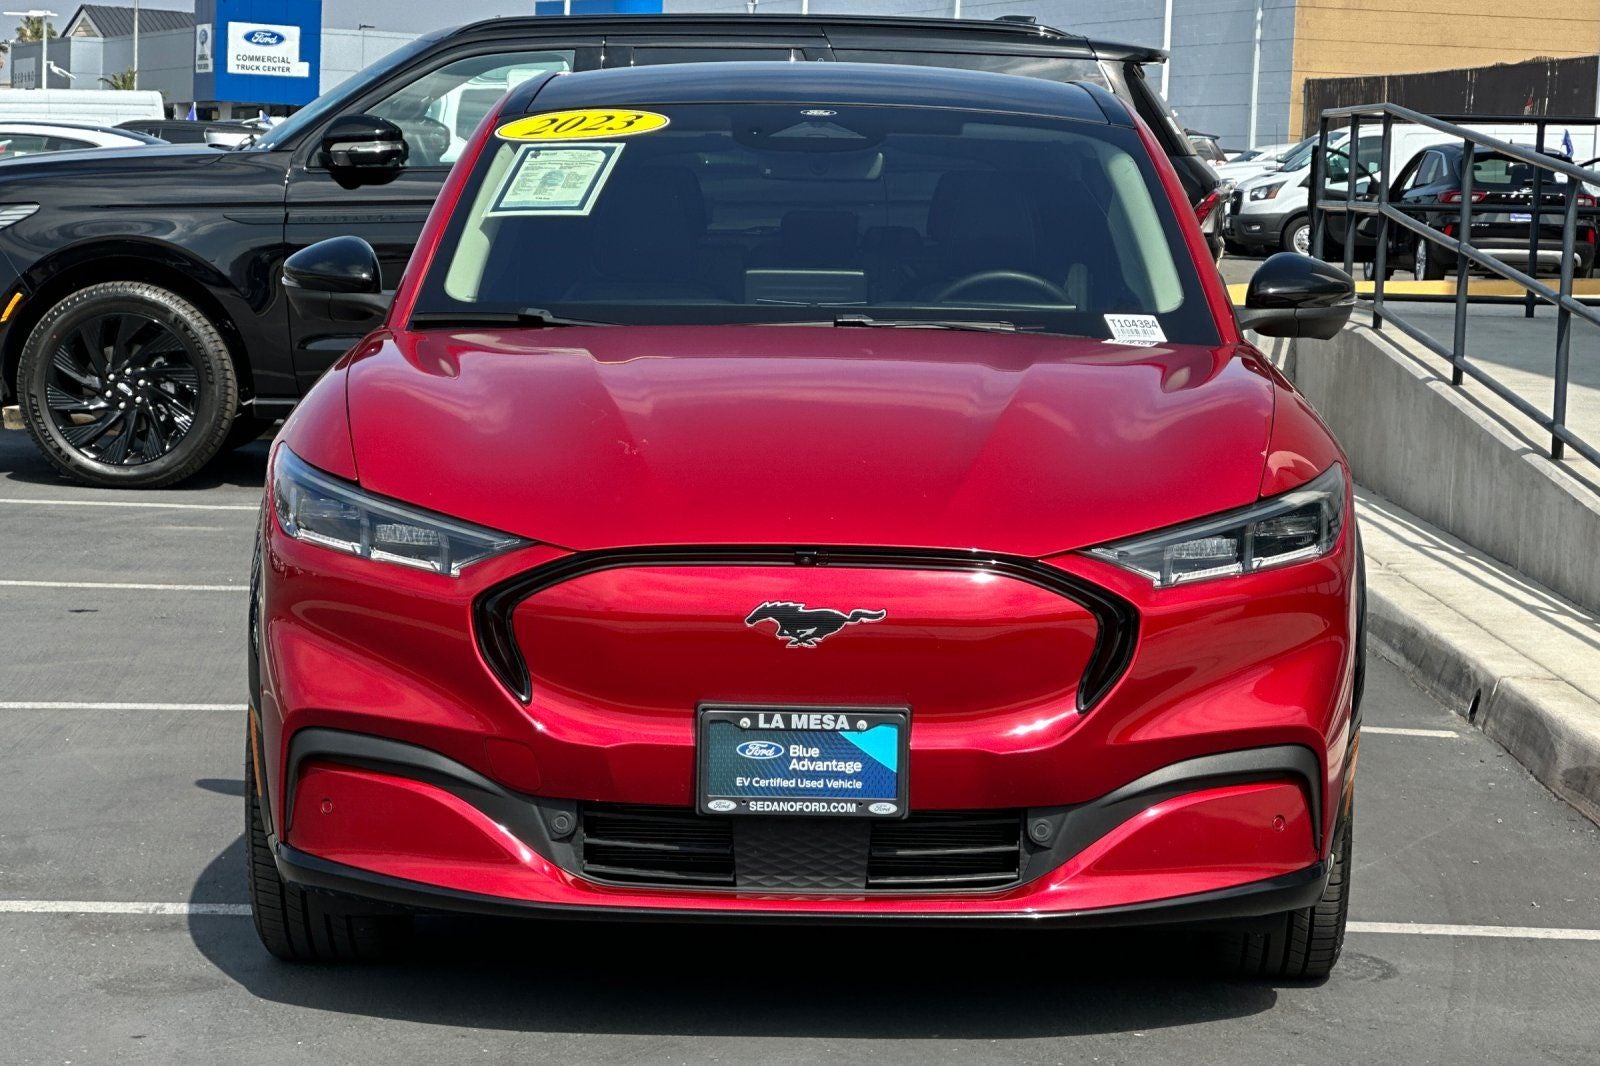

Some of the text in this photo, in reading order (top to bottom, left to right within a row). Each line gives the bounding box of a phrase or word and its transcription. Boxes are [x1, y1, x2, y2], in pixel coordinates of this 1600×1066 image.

[250, 30, 278, 44] Ford
[236, 54, 291, 64] COMMERCIAL
[236, 64, 291, 73] TRUCK CENTER
[522, 115, 644, 136] 2023
[1109, 319, 1158, 329] T104384
[758, 714, 850, 730] LA MESA
[744, 743, 776, 757] Ford
[789, 745, 820, 758] Blue
[789, 759, 863, 774] Advantage
[736, 777, 863, 789] EV Certified Used Vehicle
[749, 801, 856, 813] SEDANOFORD.COM
